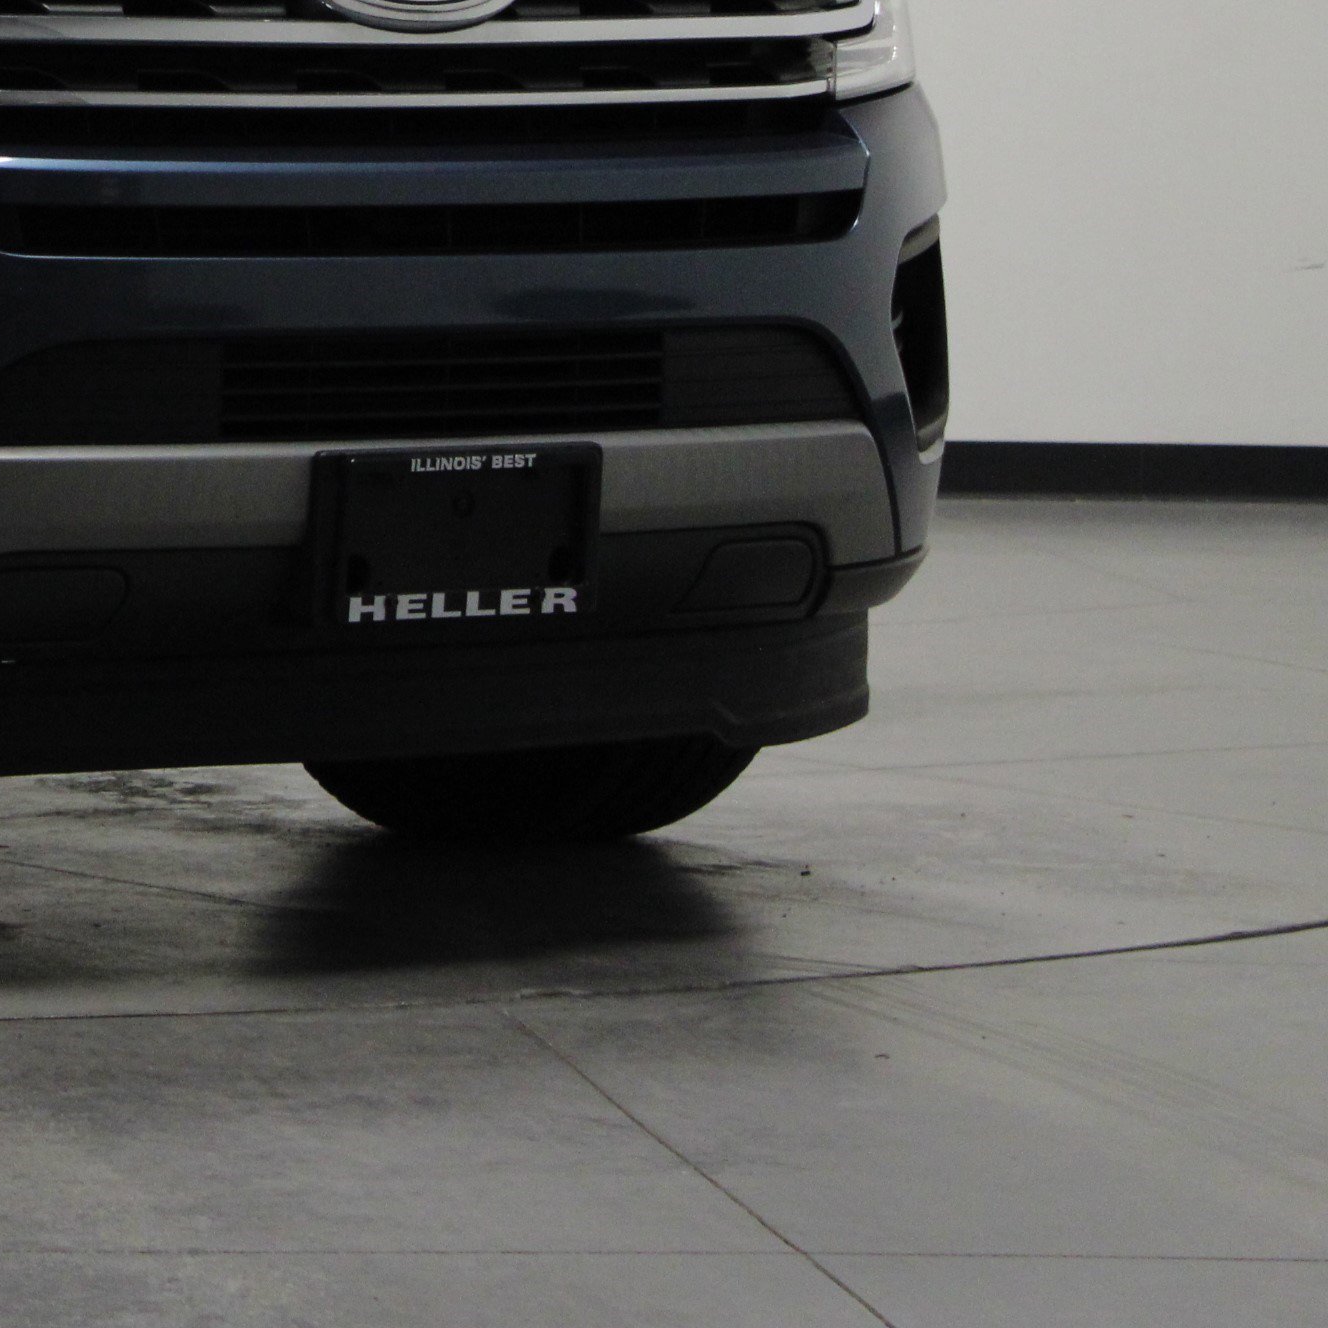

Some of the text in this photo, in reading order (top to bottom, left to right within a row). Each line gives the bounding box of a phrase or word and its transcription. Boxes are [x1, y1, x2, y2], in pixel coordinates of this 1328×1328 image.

[410, 453, 537, 473] ILLINOIS' BEST
[348, 587, 578, 623] HELLER
